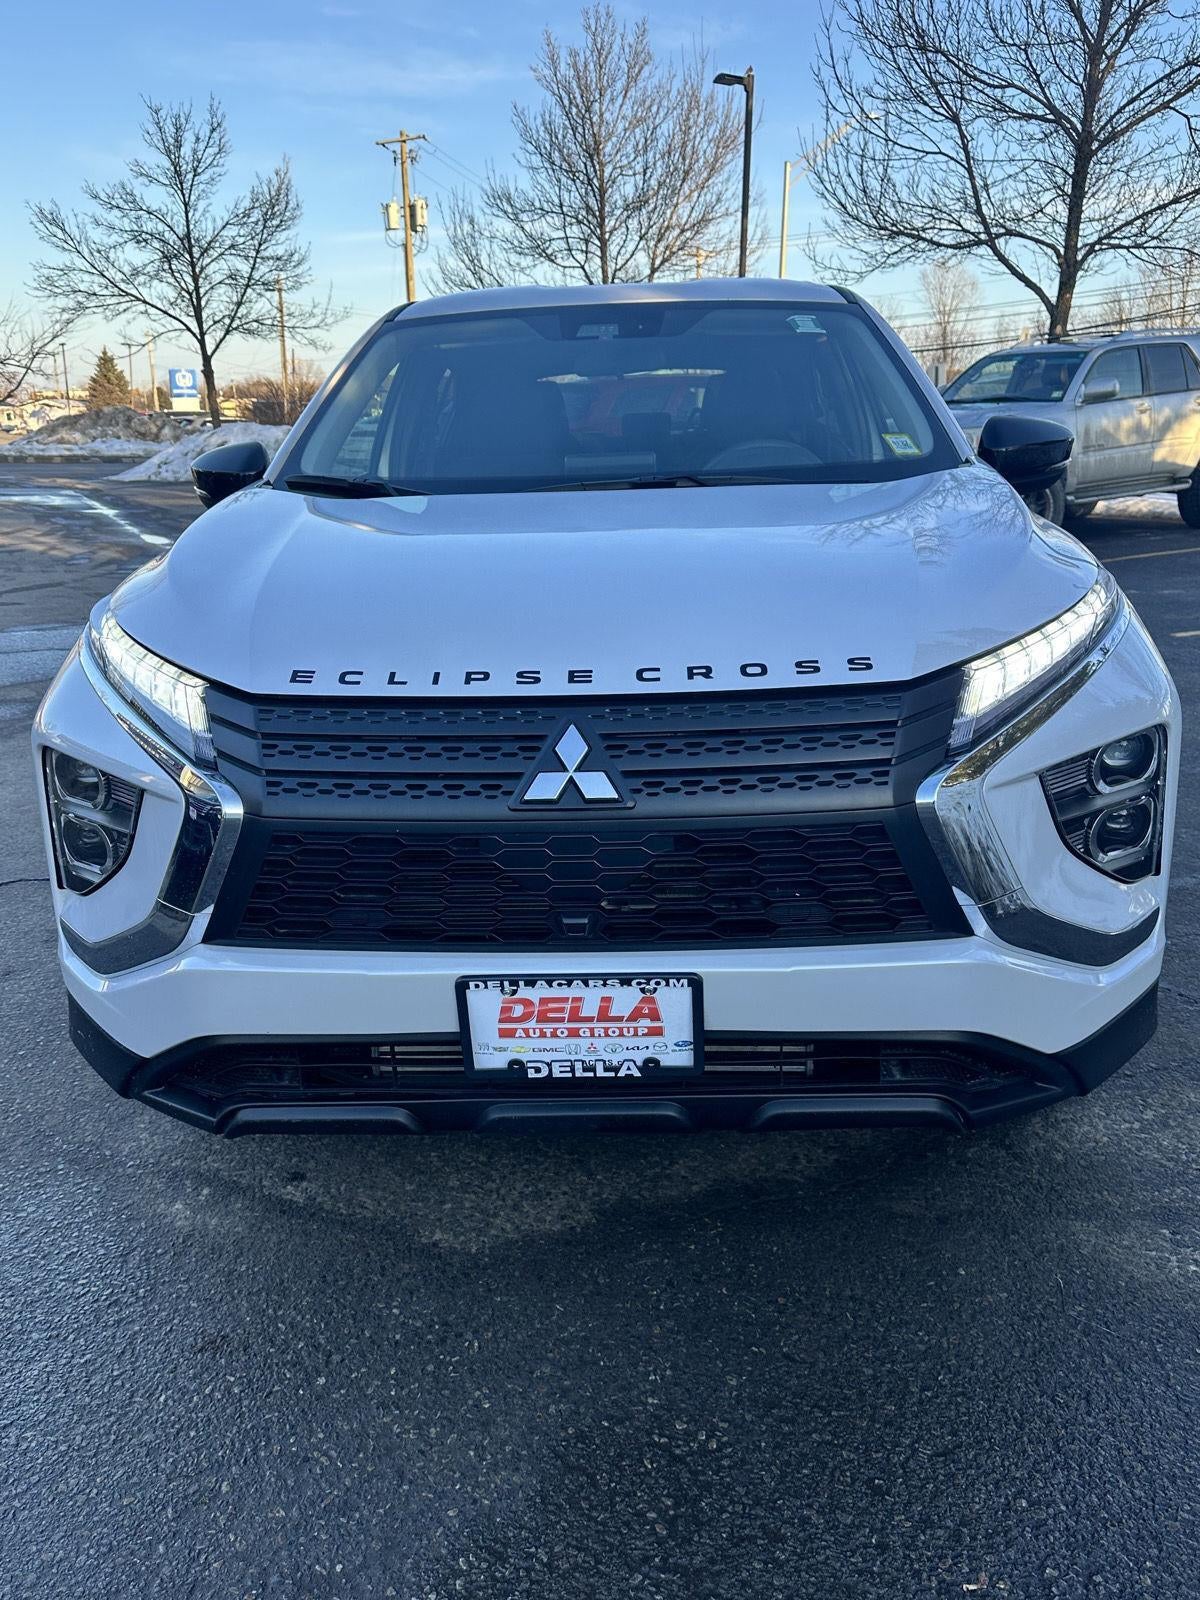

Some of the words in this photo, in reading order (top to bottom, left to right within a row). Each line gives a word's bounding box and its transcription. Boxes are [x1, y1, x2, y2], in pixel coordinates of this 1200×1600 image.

[289, 669, 593, 686] ECLIPSE
[635, 656, 874, 683] CROSS
[468, 978, 689, 991] DELLACARS.COM
[498, 995, 664, 1025] DELLA
[515, 1028, 569, 1038] AUTO
[579, 1027, 649, 1037] GROUP
[525, 1059, 642, 1078] DELLA
